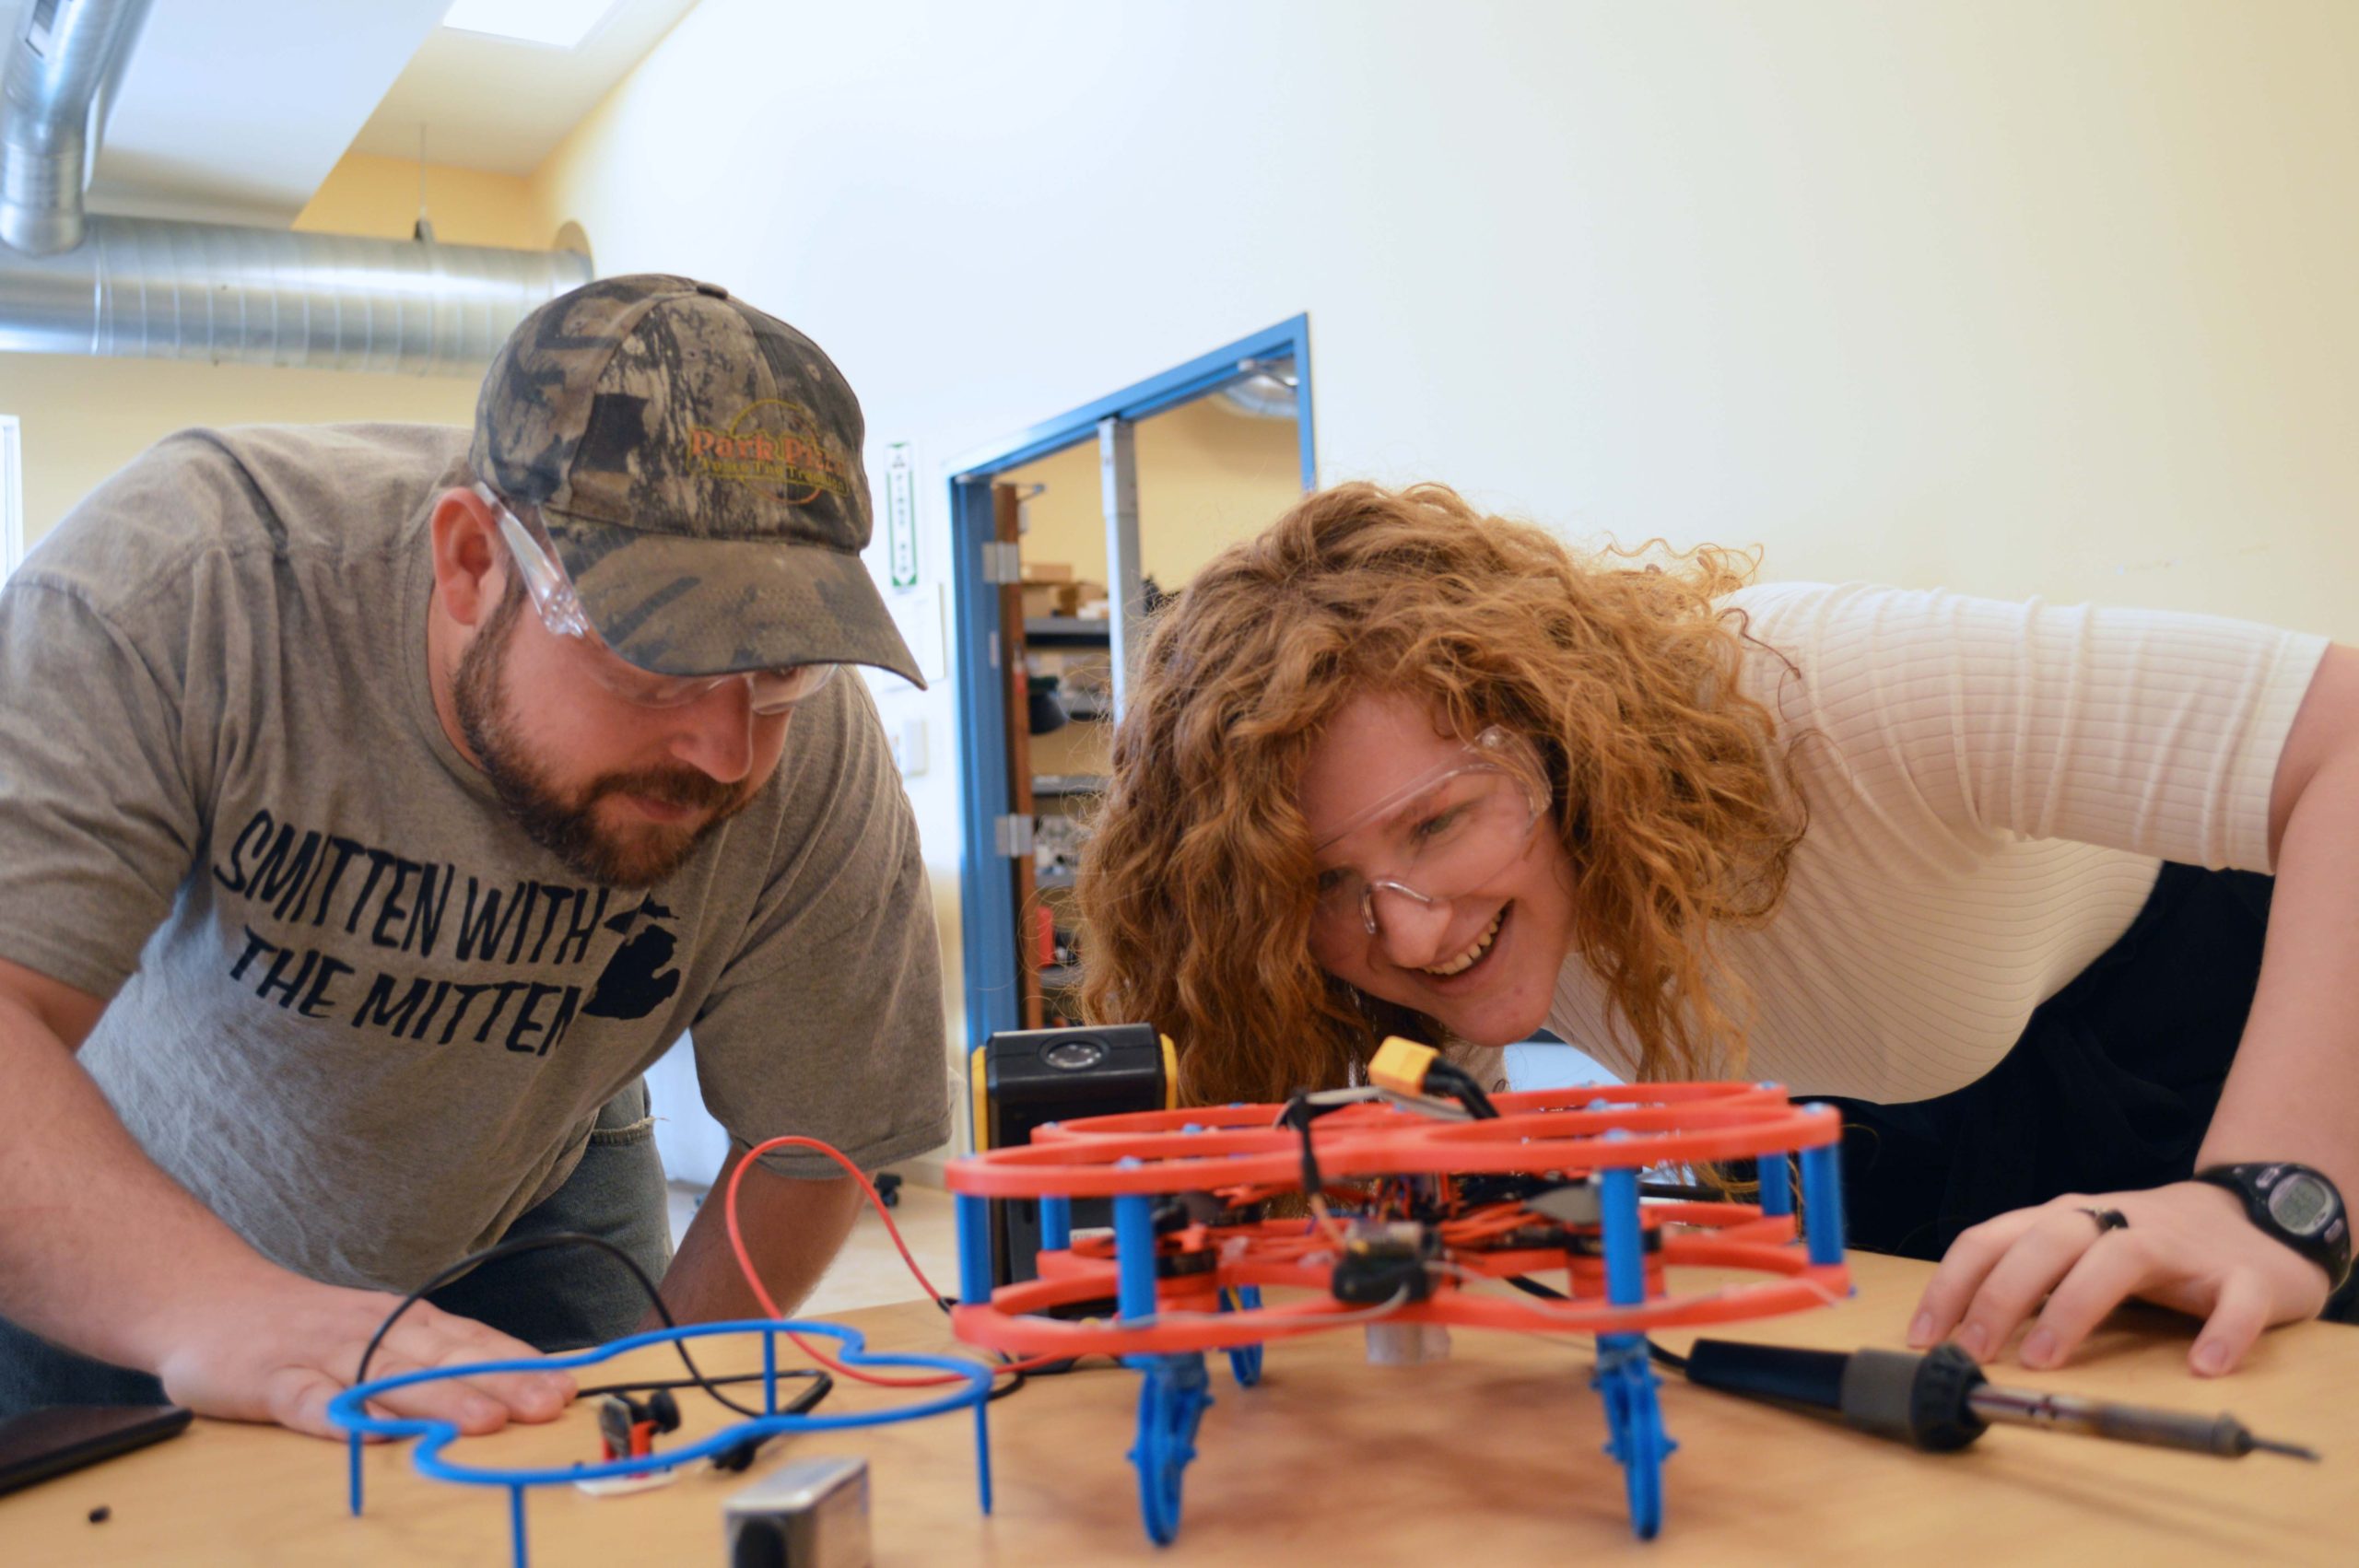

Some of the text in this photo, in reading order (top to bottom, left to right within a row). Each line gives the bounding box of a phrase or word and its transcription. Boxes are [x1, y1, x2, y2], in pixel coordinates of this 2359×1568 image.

[692, 429, 776, 462] Park
[213, 808, 610, 965] SMITTEN WITH
[229, 924, 582, 1057] THE MITTEN
